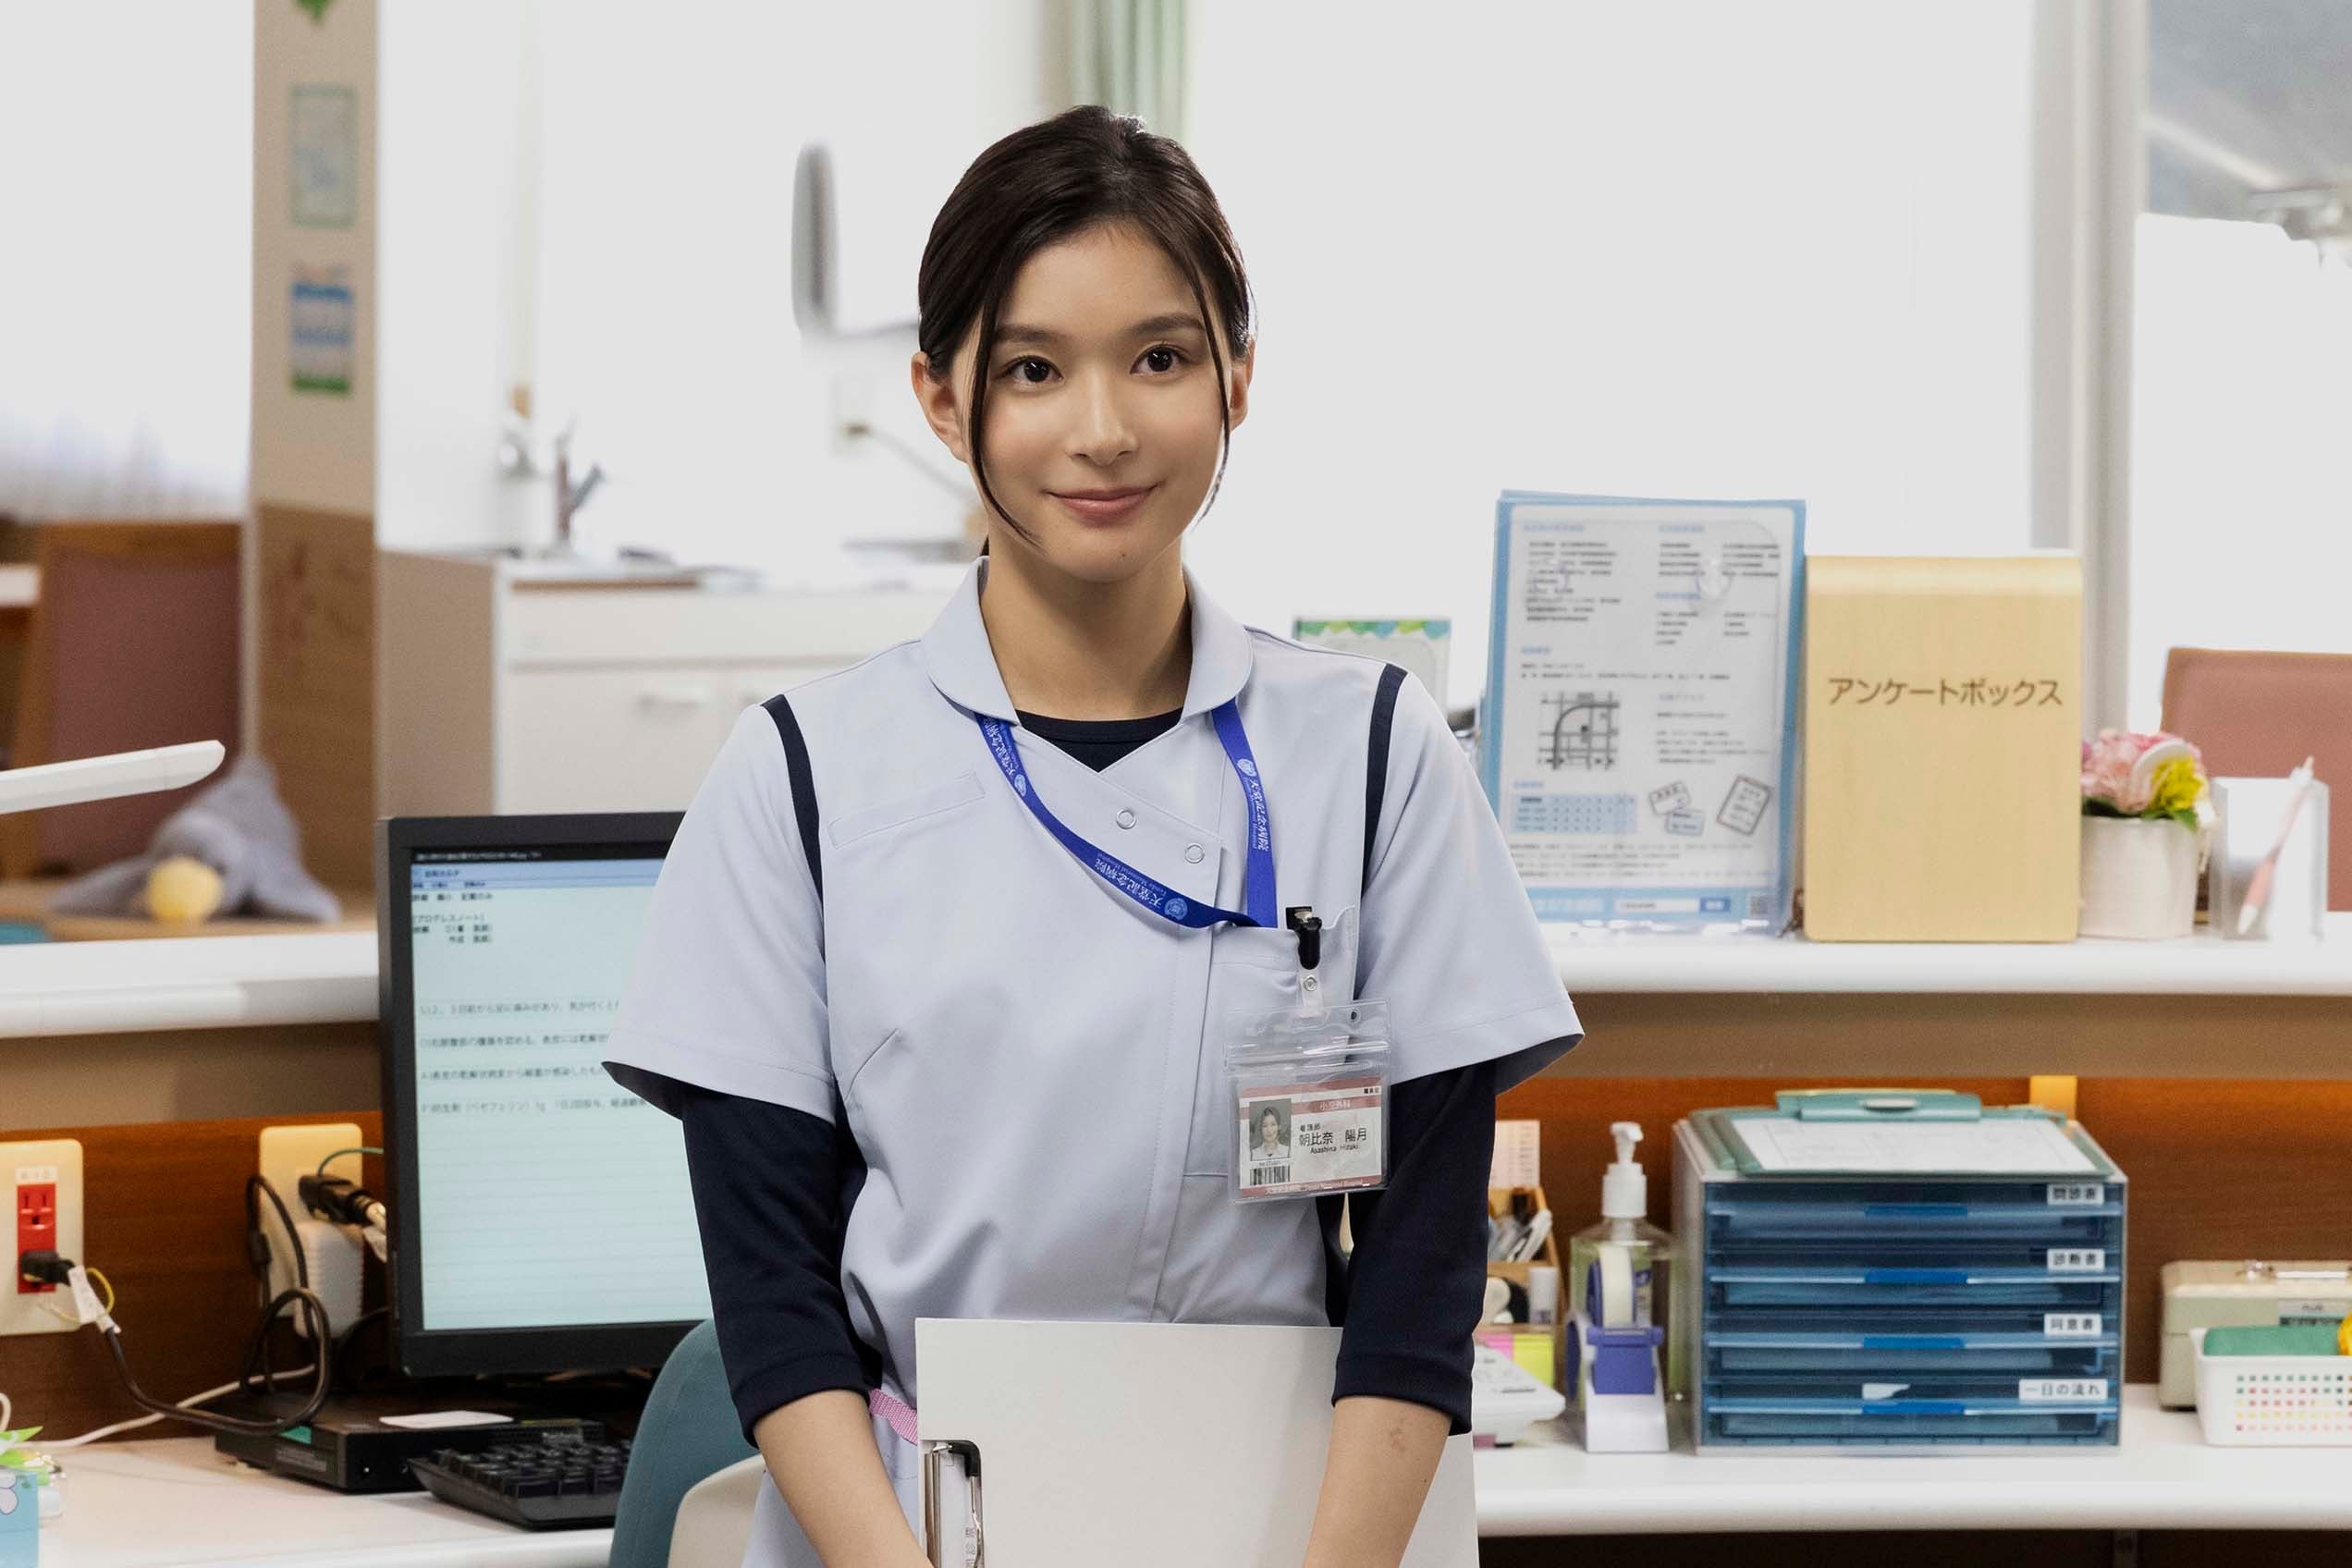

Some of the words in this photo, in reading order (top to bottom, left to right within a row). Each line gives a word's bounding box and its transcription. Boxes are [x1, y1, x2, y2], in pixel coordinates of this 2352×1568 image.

[1827, 677, 2064, 707] アンケートボックス
[1094, 857, 1165, 908] 天堂記念病院
[1299, 1132, 1333, 1146] 朝比奈
[1345, 1127, 1367, 1143] 陽月
[2049, 1317, 2094, 1331] 同意書
[2025, 1383, 2101, 1397] 一日の流れ
